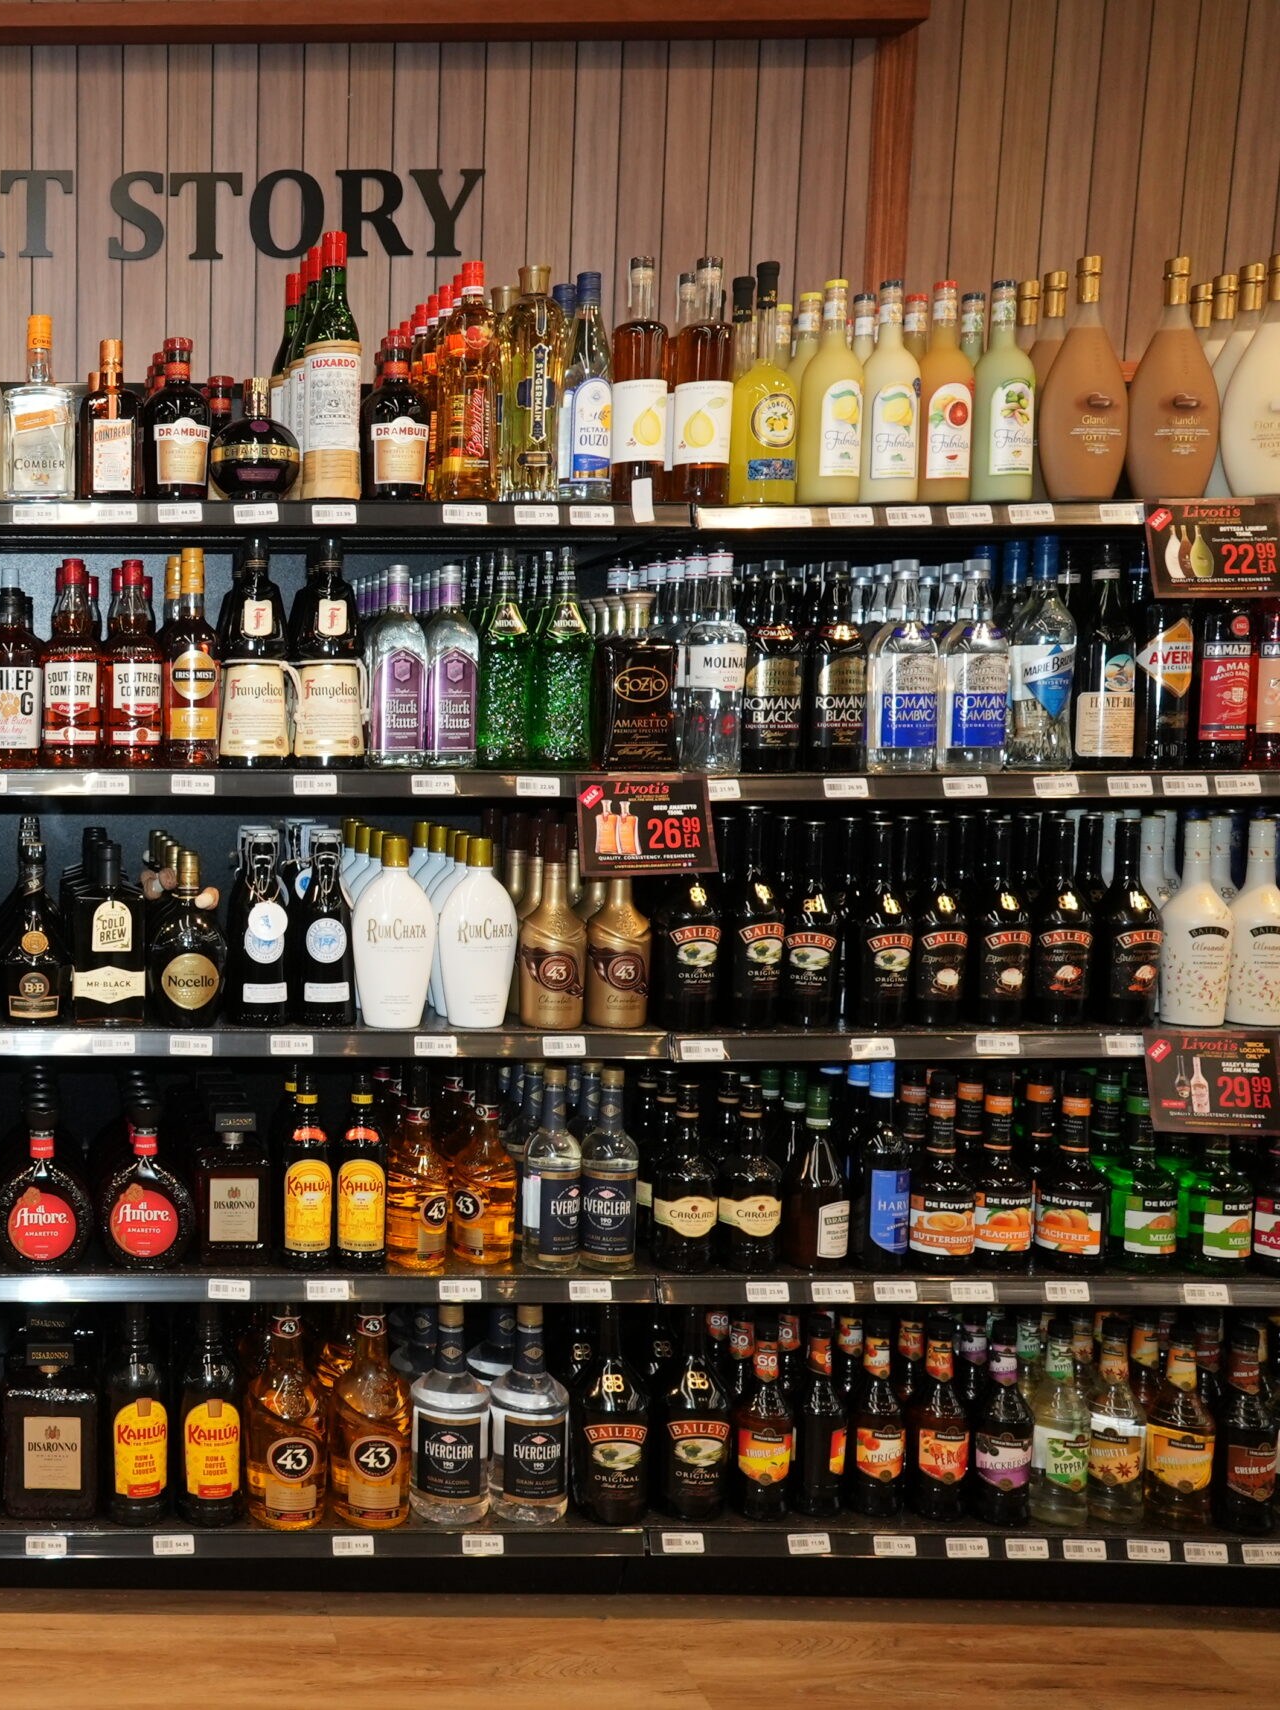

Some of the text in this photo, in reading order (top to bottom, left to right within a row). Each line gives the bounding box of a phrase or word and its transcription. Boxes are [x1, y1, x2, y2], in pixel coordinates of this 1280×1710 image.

[108, 168, 485, 261] STORY
[311, 357, 357, 369] LUXARDO
[534, 363, 543, 422] ST-GERMAIN
[158, 426, 208, 440] DRAMBUIE
[376, 425, 427, 439] DRAMBUIE
[579, 433, 608, 446] OUZO
[224, 445, 293, 458] CHAMBORD
[14, 457, 65, 470] COMBIER
[1183, 505, 1240, 518] Livoti's
[1151, 513, 1167, 527] SALE
[1221, 542, 1276, 574] 22 99
[1259, 560, 1277, 574] EA
[47, 671, 94, 685] SOUTHERN
[50, 684, 91, 697] COMFORT
[229, 678, 283, 698] Frangelico
[304, 678, 357, 698] Frangelico
[386, 699, 417, 715] Black
[439, 699, 471, 715] Black
[743, 697, 801, 710] ROMANA
[614, 718, 668, 728] AMARETTO
[752, 710, 792, 723] BLACK
[826, 710, 862, 722] BLACK
[614, 782, 670, 794] Livoti's
[583, 789, 599, 805] SALE
[647, 817, 700, 849] 26 99
[684, 834, 700, 848] EA
[101, 915, 125, 930] COLD
[99, 927, 127, 942] BREW
[1044, 933, 1092, 945] BAILEYS
[167, 974, 215, 989] Nocello
[1151, 1043, 1166, 1058] SALE
[1181, 1036, 1238, 1051] Livoti's
[1217, 1076, 1272, 1107] 29 99
[1254, 1094, 1271, 1108] EA
[213, 1200, 256, 1210] DISARONNO
[583, 1200, 631, 1216] EVERCLEAR
[1037, 1226, 1090, 1242] PEACHTREE
[757, 1355, 778, 1366] 60
[117, 1423, 166, 1445] KAHLÚA
[187, 1423, 239, 1445] KAHLÚA
[587, 1425, 647, 1441] BAILEYS
[672, 1422, 729, 1438] BAILEYS
[27, 1441, 78, 1452] DISARONNO
[424, 1441, 474, 1460] EVERCLEAR
[513, 1441, 561, 1460] EVERCLEAR
[276, 1448, 308, 1470] 43
[358, 1446, 391, 1468] 43
[594, 1474, 639, 1483] ORIGINAL
